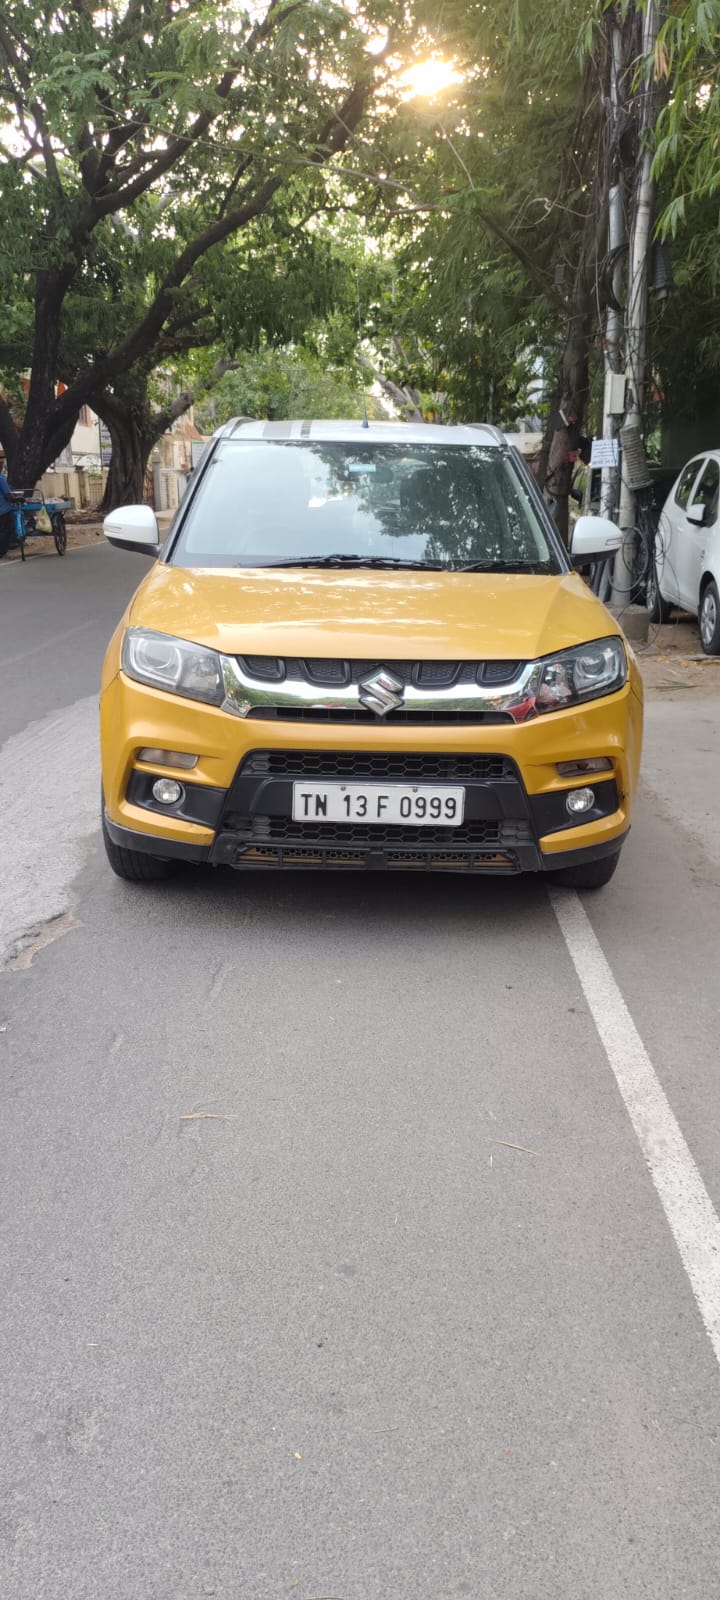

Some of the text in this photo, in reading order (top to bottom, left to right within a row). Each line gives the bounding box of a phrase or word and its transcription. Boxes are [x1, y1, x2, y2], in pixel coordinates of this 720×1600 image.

[301, 793, 457, 819] TN 13 F 0999
